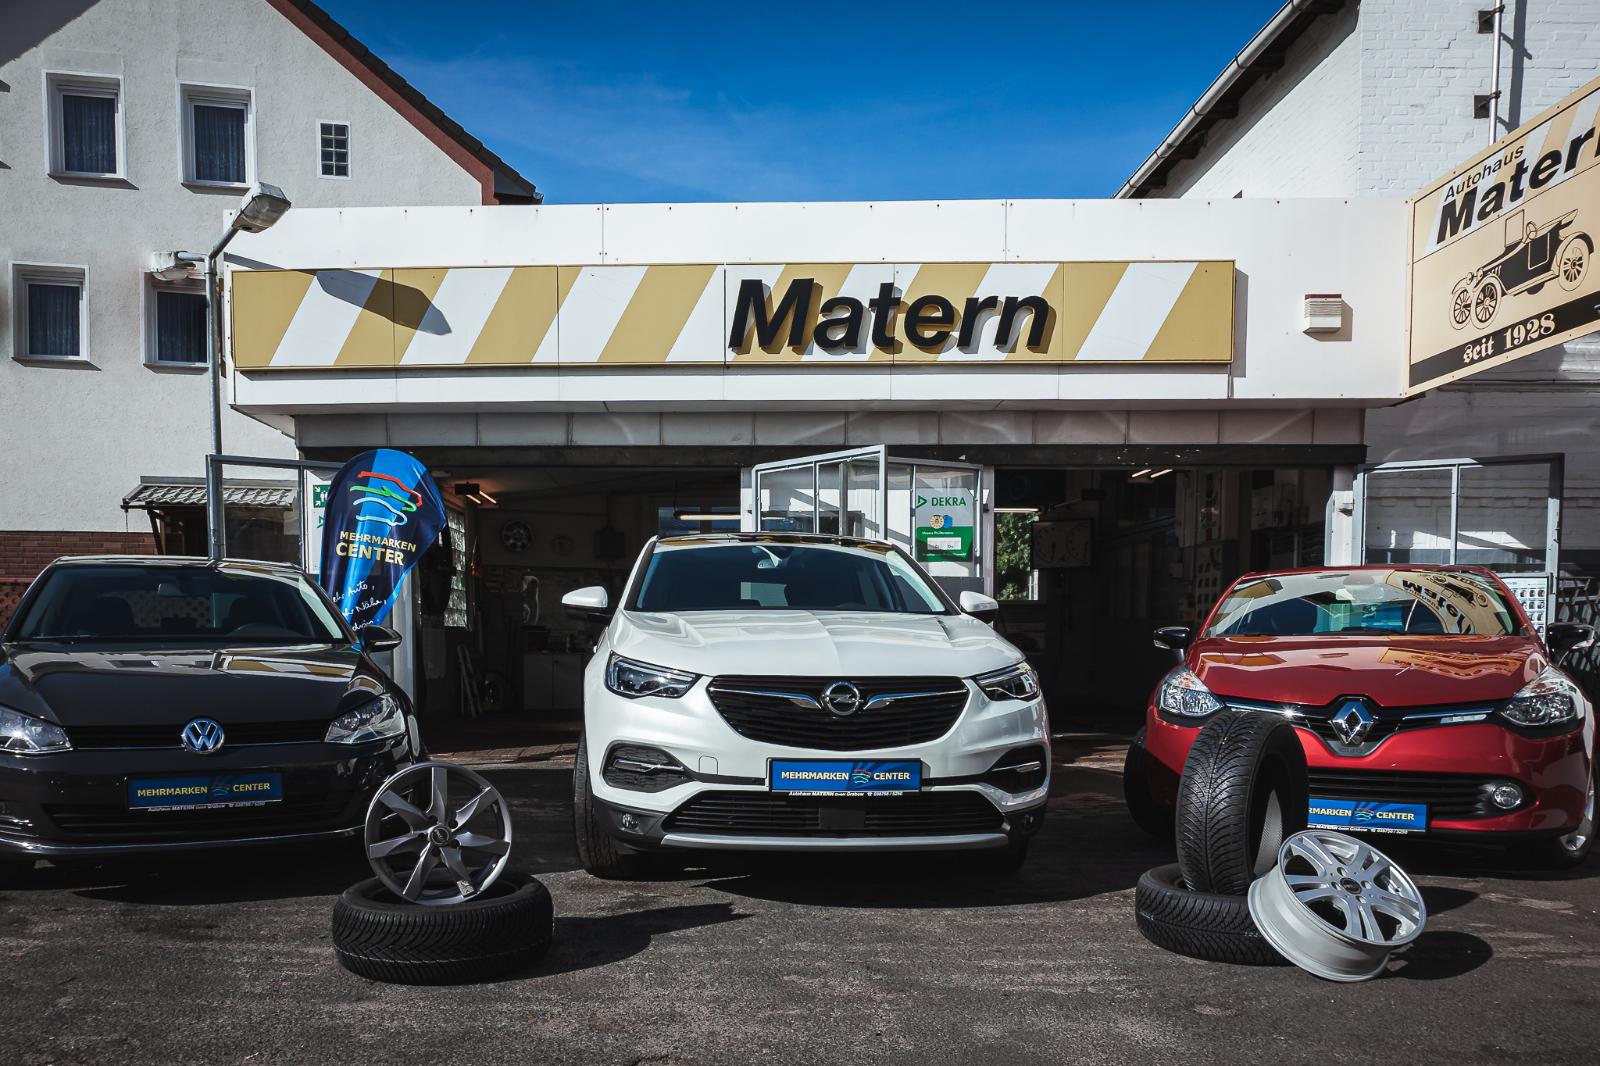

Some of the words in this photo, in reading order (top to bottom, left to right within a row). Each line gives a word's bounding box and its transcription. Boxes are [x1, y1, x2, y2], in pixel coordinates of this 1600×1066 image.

[1436, 124, 1600, 245] Mater
[1444, 144, 1525, 202] Autohaus
[728, 278, 1051, 351] Matern
[1463, 335, 1495, 364] seit
[1503, 312, 1555, 350] 1928
[931, 497, 967, 507] DEKRA
[335, 541, 405, 566] CENTER
[339, 530, 417, 553] MEHRMARKEN
[781, 771, 849, 780] MEHRMARKEN
[873, 772, 911, 780] CENTER
[137, 786, 208, 797] MEHRMARKEN
[233, 783, 271, 792] CENTER
[1376, 811, 1415, 820] CENTER
